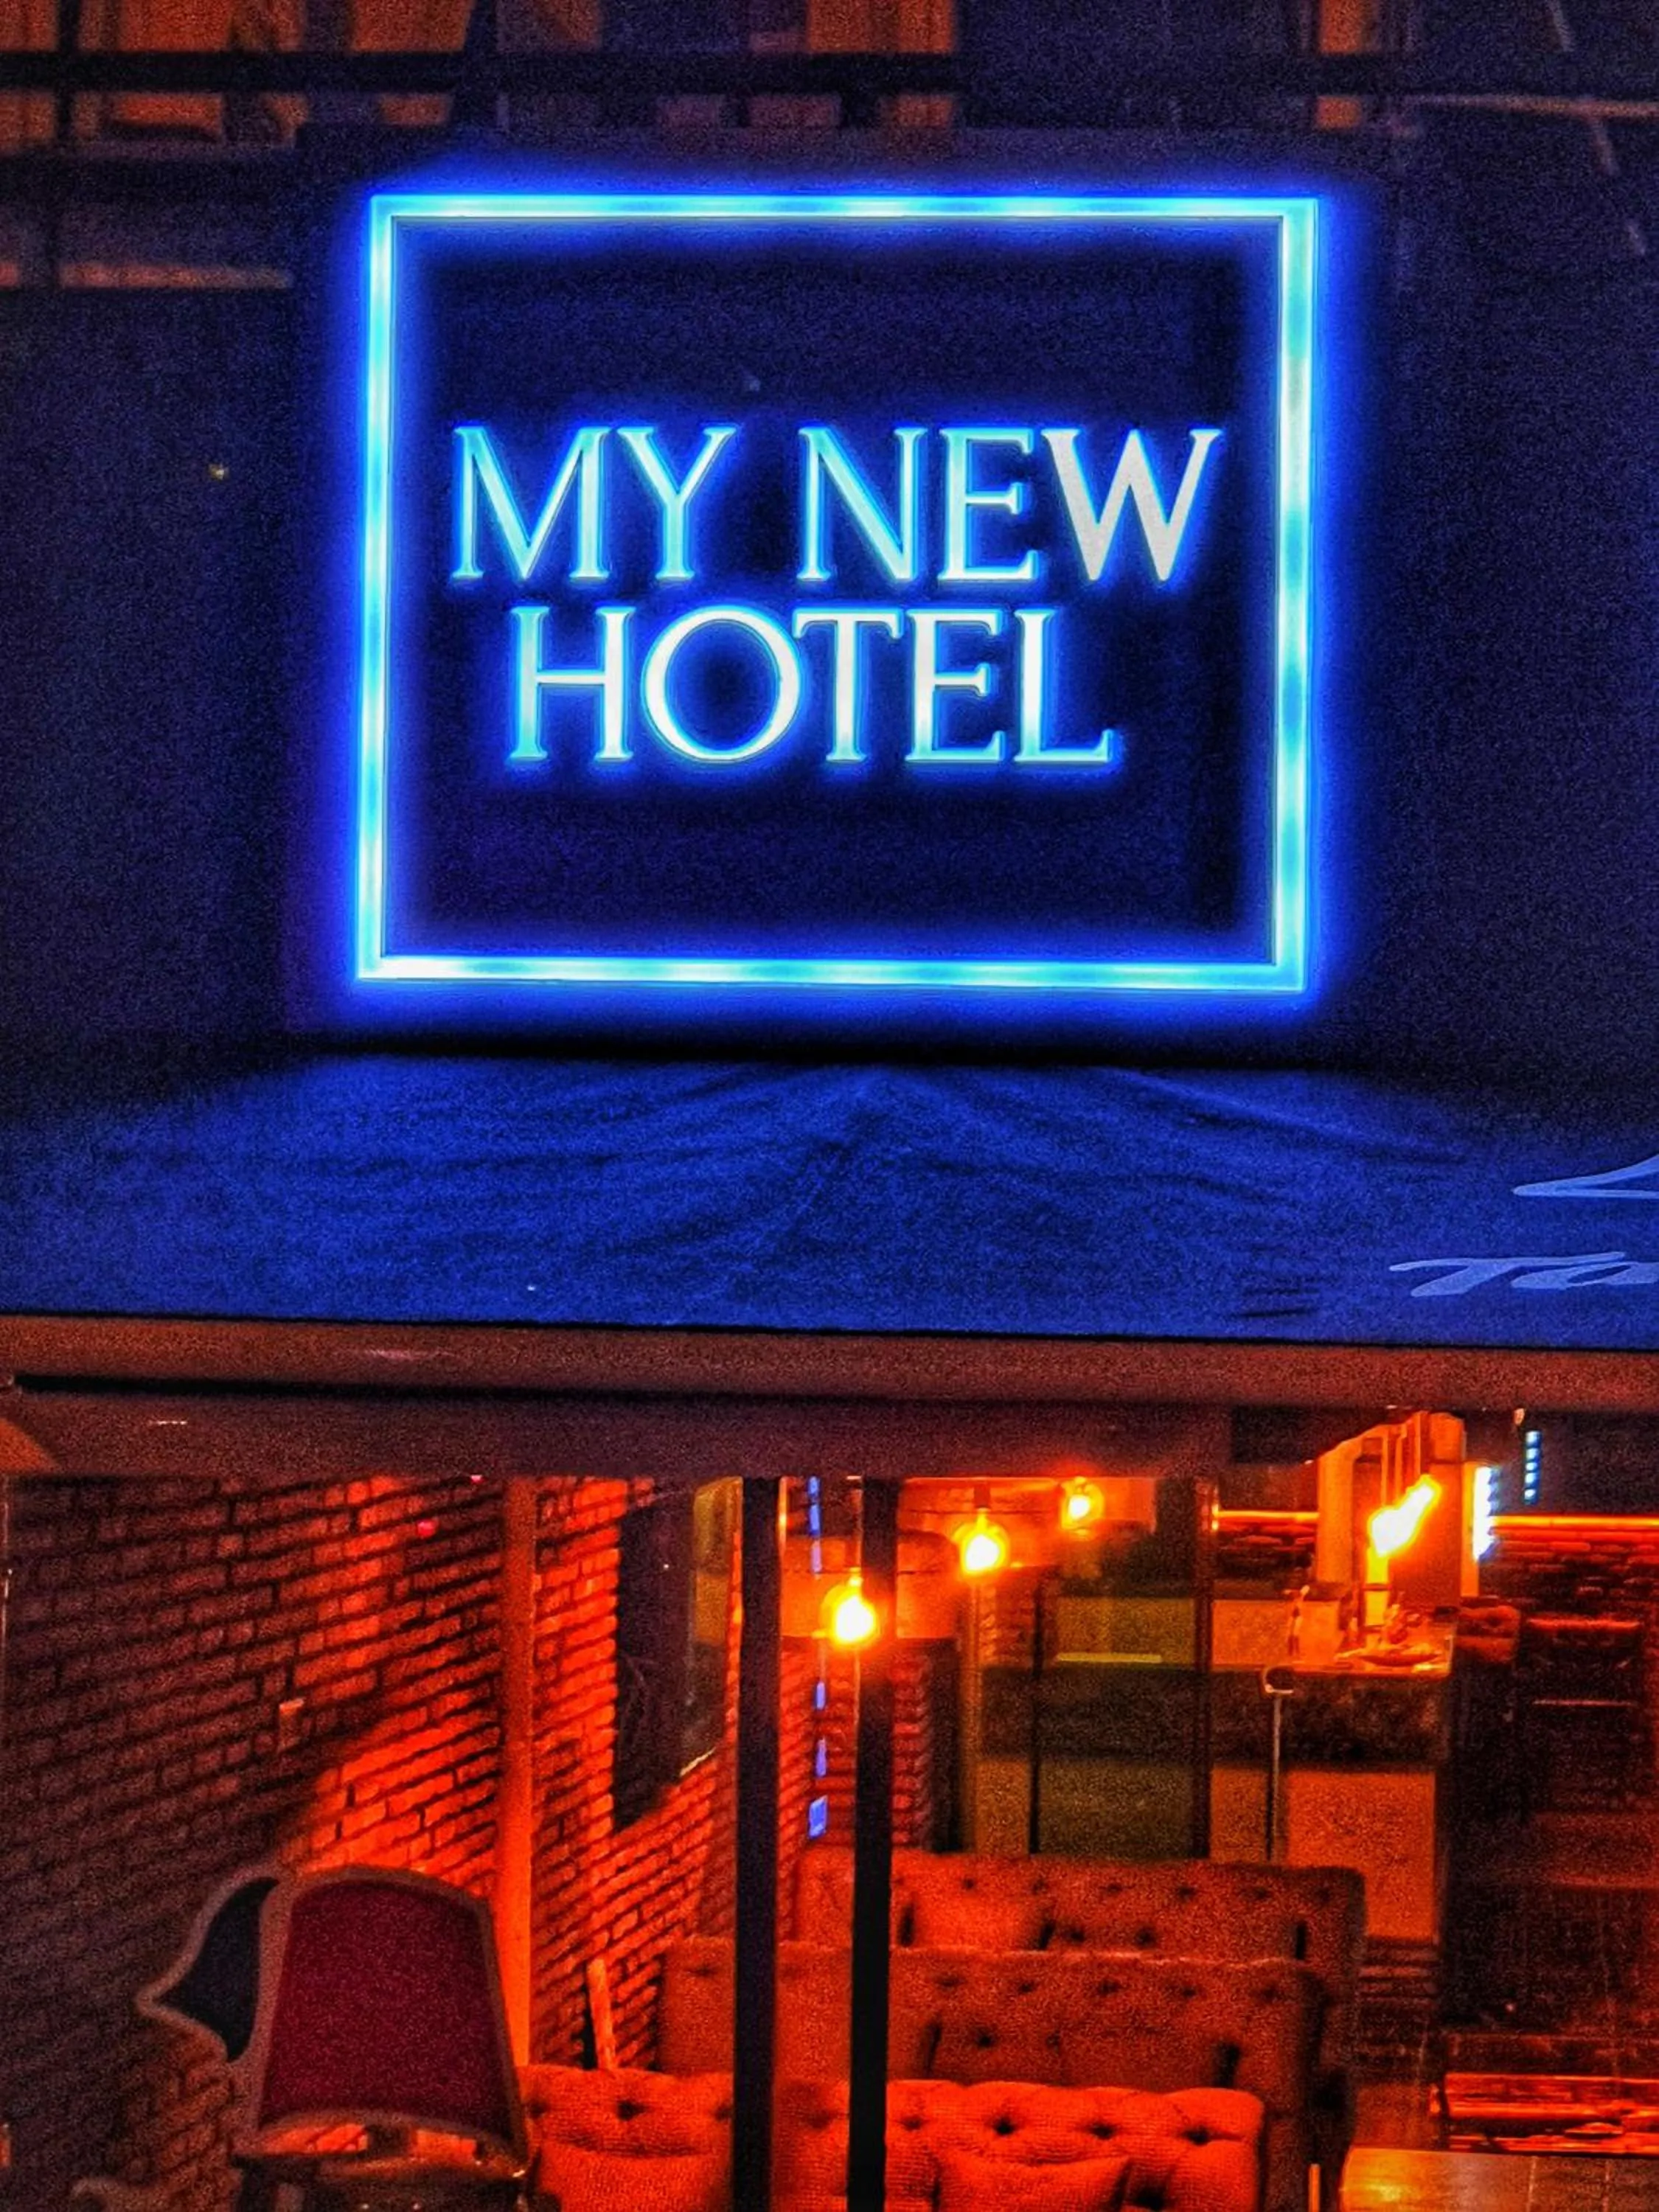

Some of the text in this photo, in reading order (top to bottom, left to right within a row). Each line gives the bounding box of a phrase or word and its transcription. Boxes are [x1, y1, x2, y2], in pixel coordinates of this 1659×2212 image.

[452, 426, 1222, 583] MY NEW
[509, 605, 1114, 764] HOTEL
